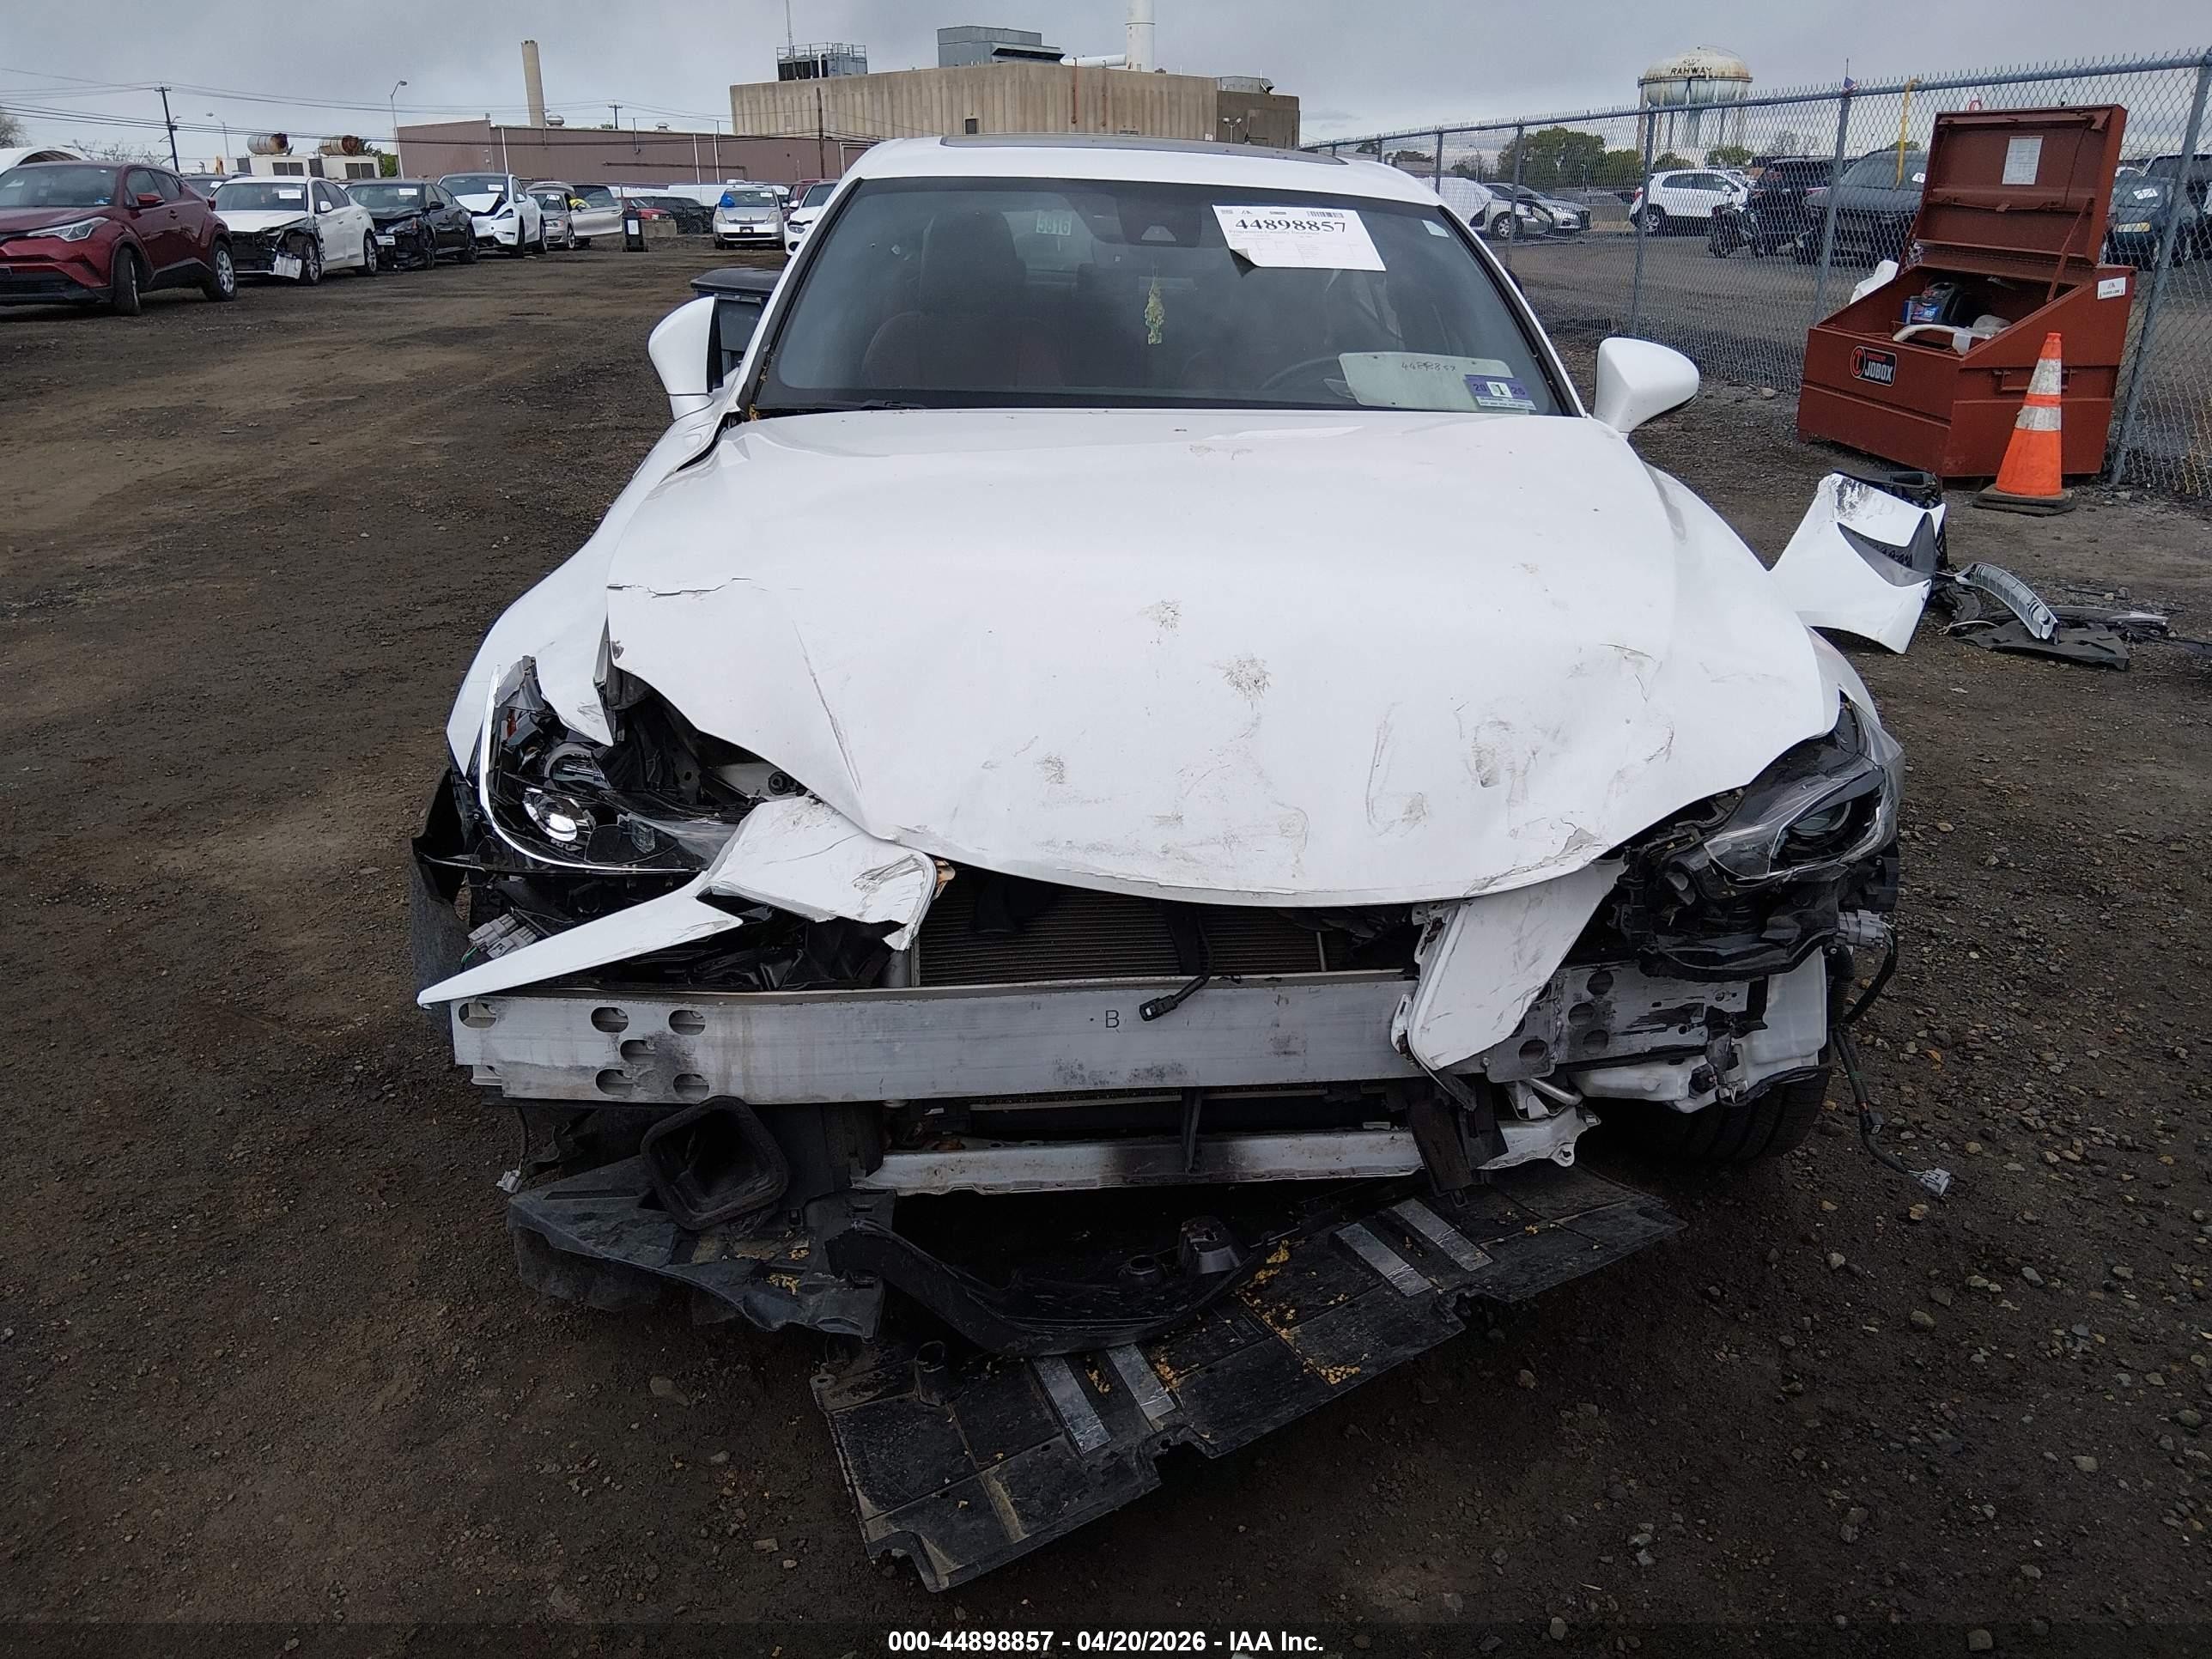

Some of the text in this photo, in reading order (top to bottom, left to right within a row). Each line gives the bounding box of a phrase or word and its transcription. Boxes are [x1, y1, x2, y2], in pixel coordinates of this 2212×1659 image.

[1670, 67, 1712, 76] RAHWAY
[1236, 218, 1346, 233] 44898857
[1864, 361, 1893, 382] JOBOX
[1473, 383, 1487, 392] 20
[1105, 1010, 1120, 1028] B
